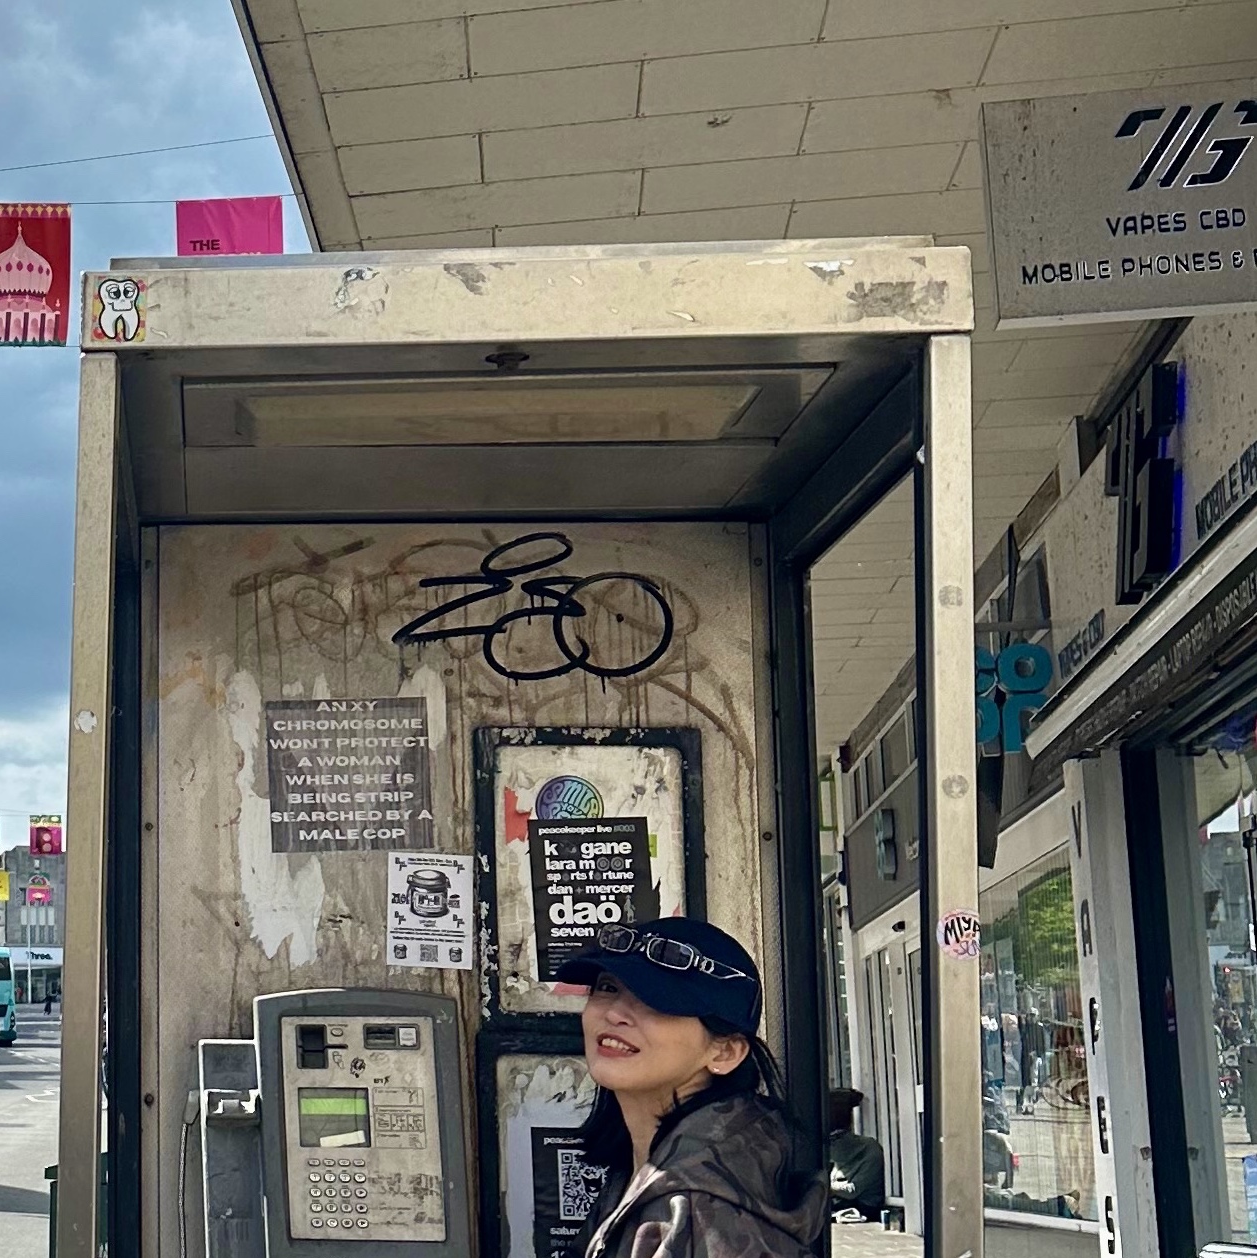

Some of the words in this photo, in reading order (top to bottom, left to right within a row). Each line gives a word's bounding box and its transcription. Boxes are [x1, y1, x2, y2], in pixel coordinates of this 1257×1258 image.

[1105, 212, 1187, 238] VAPES
[1199, 207, 1246, 231] CBD
[189, 239, 220, 252] THE
[1021, 259, 1111, 286] MOBILE
[1120, 250, 1224, 278] PHONES
[1195, 457, 1239, 540] MOBILE
[316, 701, 347, 712] AN
[351, 700, 378, 711] XY
[273, 718, 423, 731] CHROMOSOME
[336, 736, 429, 748] PROTECT
[297, 756, 313, 767] A
[316, 755, 401, 767] WOMAN
[285, 774, 349, 786] WHEN
[352, 774, 392, 785] SHE
[396, 773, 415, 784] IS
[288, 792, 352, 804] BEING
[354, 791, 414, 803] STRIP
[270, 810, 383, 823] SEARCHED
[386, 809, 413, 821] BY
[417, 809, 433, 820] A
[299, 828, 359, 841] MALE
[362, 828, 406, 840] COP
[538, 825, 596, 836] peacekeeper
[596, 824, 613, 833] live
[545, 857, 576, 870] lara
[547, 883, 573, 894] dan
[585, 884, 635, 894] mercer
[550, 927, 595, 937] seven
